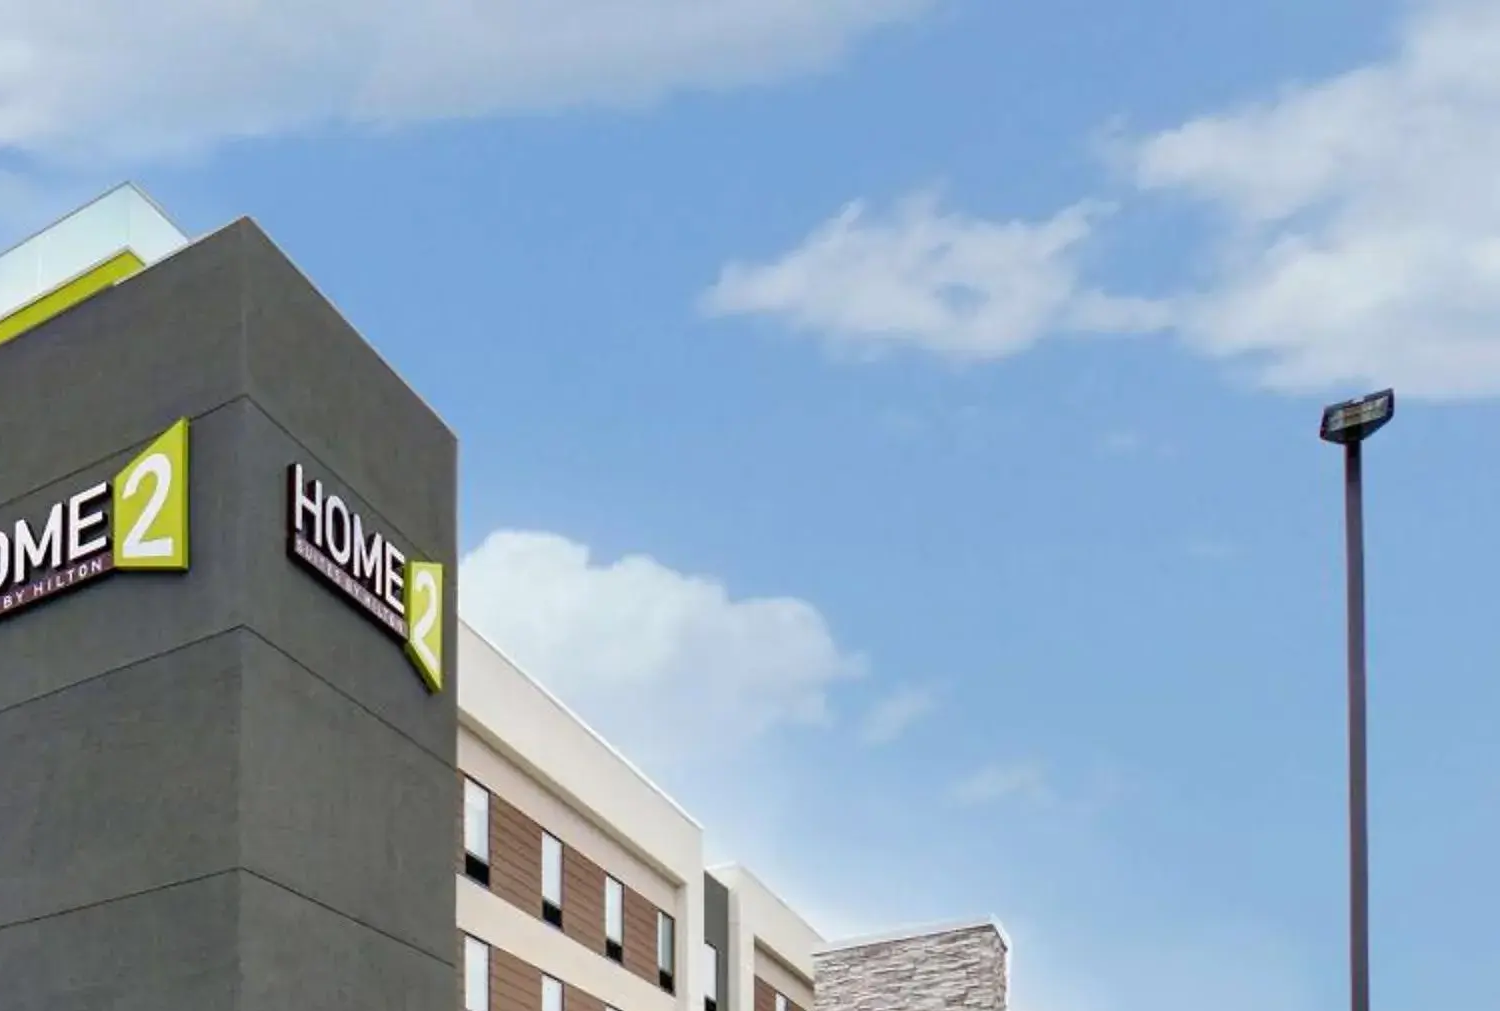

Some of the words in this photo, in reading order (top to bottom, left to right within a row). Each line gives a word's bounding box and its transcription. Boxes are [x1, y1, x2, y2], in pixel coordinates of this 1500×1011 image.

[121, 453, 174, 559] 2
[3, 590, 25, 609] BY
[33, 559, 103, 597] HILTON
[295, 463, 405, 614] HOME
[409, 569, 441, 672] 2
